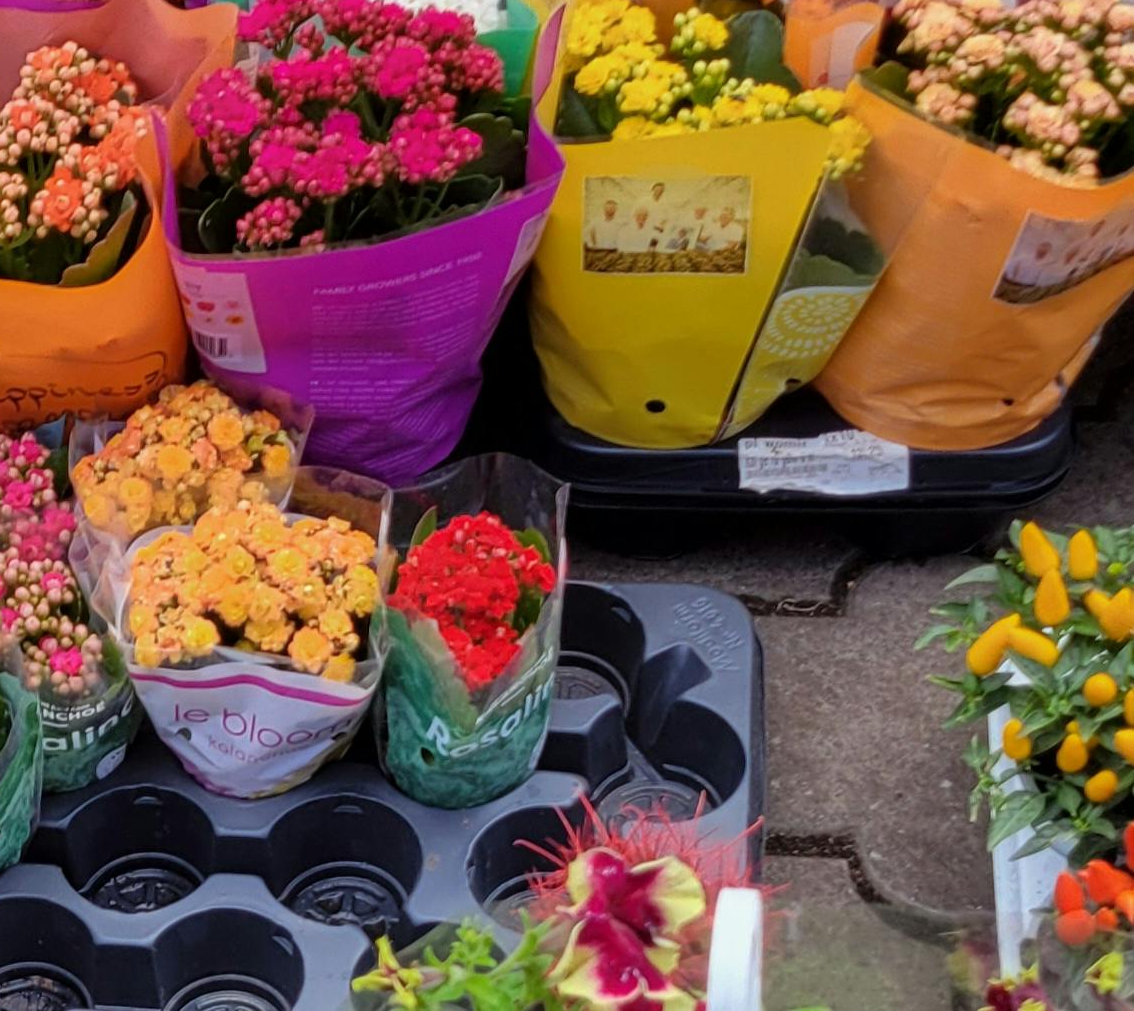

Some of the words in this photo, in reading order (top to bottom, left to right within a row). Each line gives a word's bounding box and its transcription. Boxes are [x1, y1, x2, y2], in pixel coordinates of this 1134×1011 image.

[357, 272, 417, 293] GROWERS
[419, 261, 454, 280] SINCE
[174, 703, 211, 723] le
